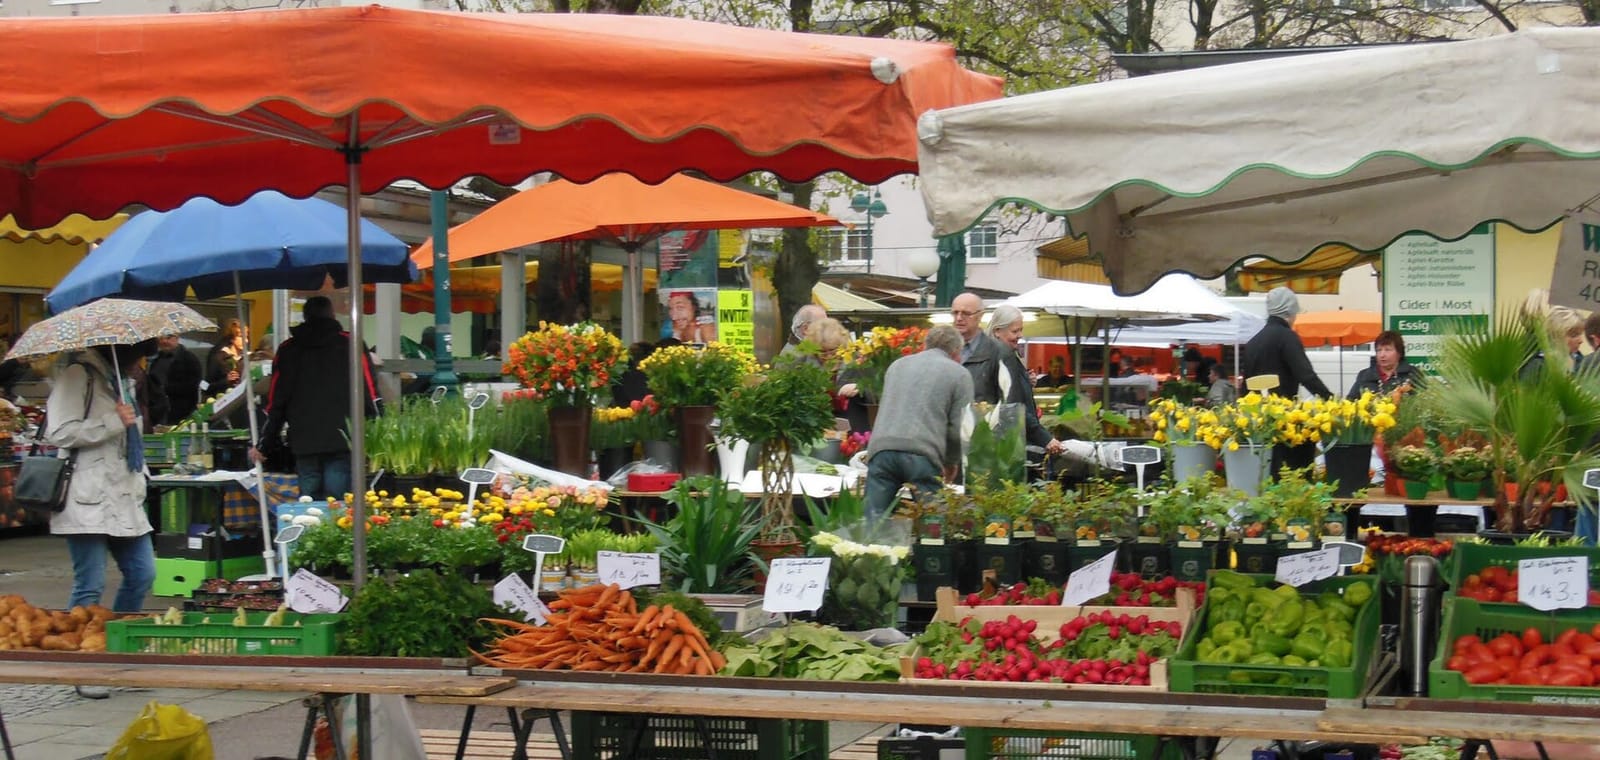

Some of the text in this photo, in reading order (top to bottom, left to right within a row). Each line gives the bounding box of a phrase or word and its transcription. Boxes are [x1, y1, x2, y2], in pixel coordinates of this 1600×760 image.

[1399, 299, 1472, 310] Cider Most
[1399, 320, 1430, 331] Essig
